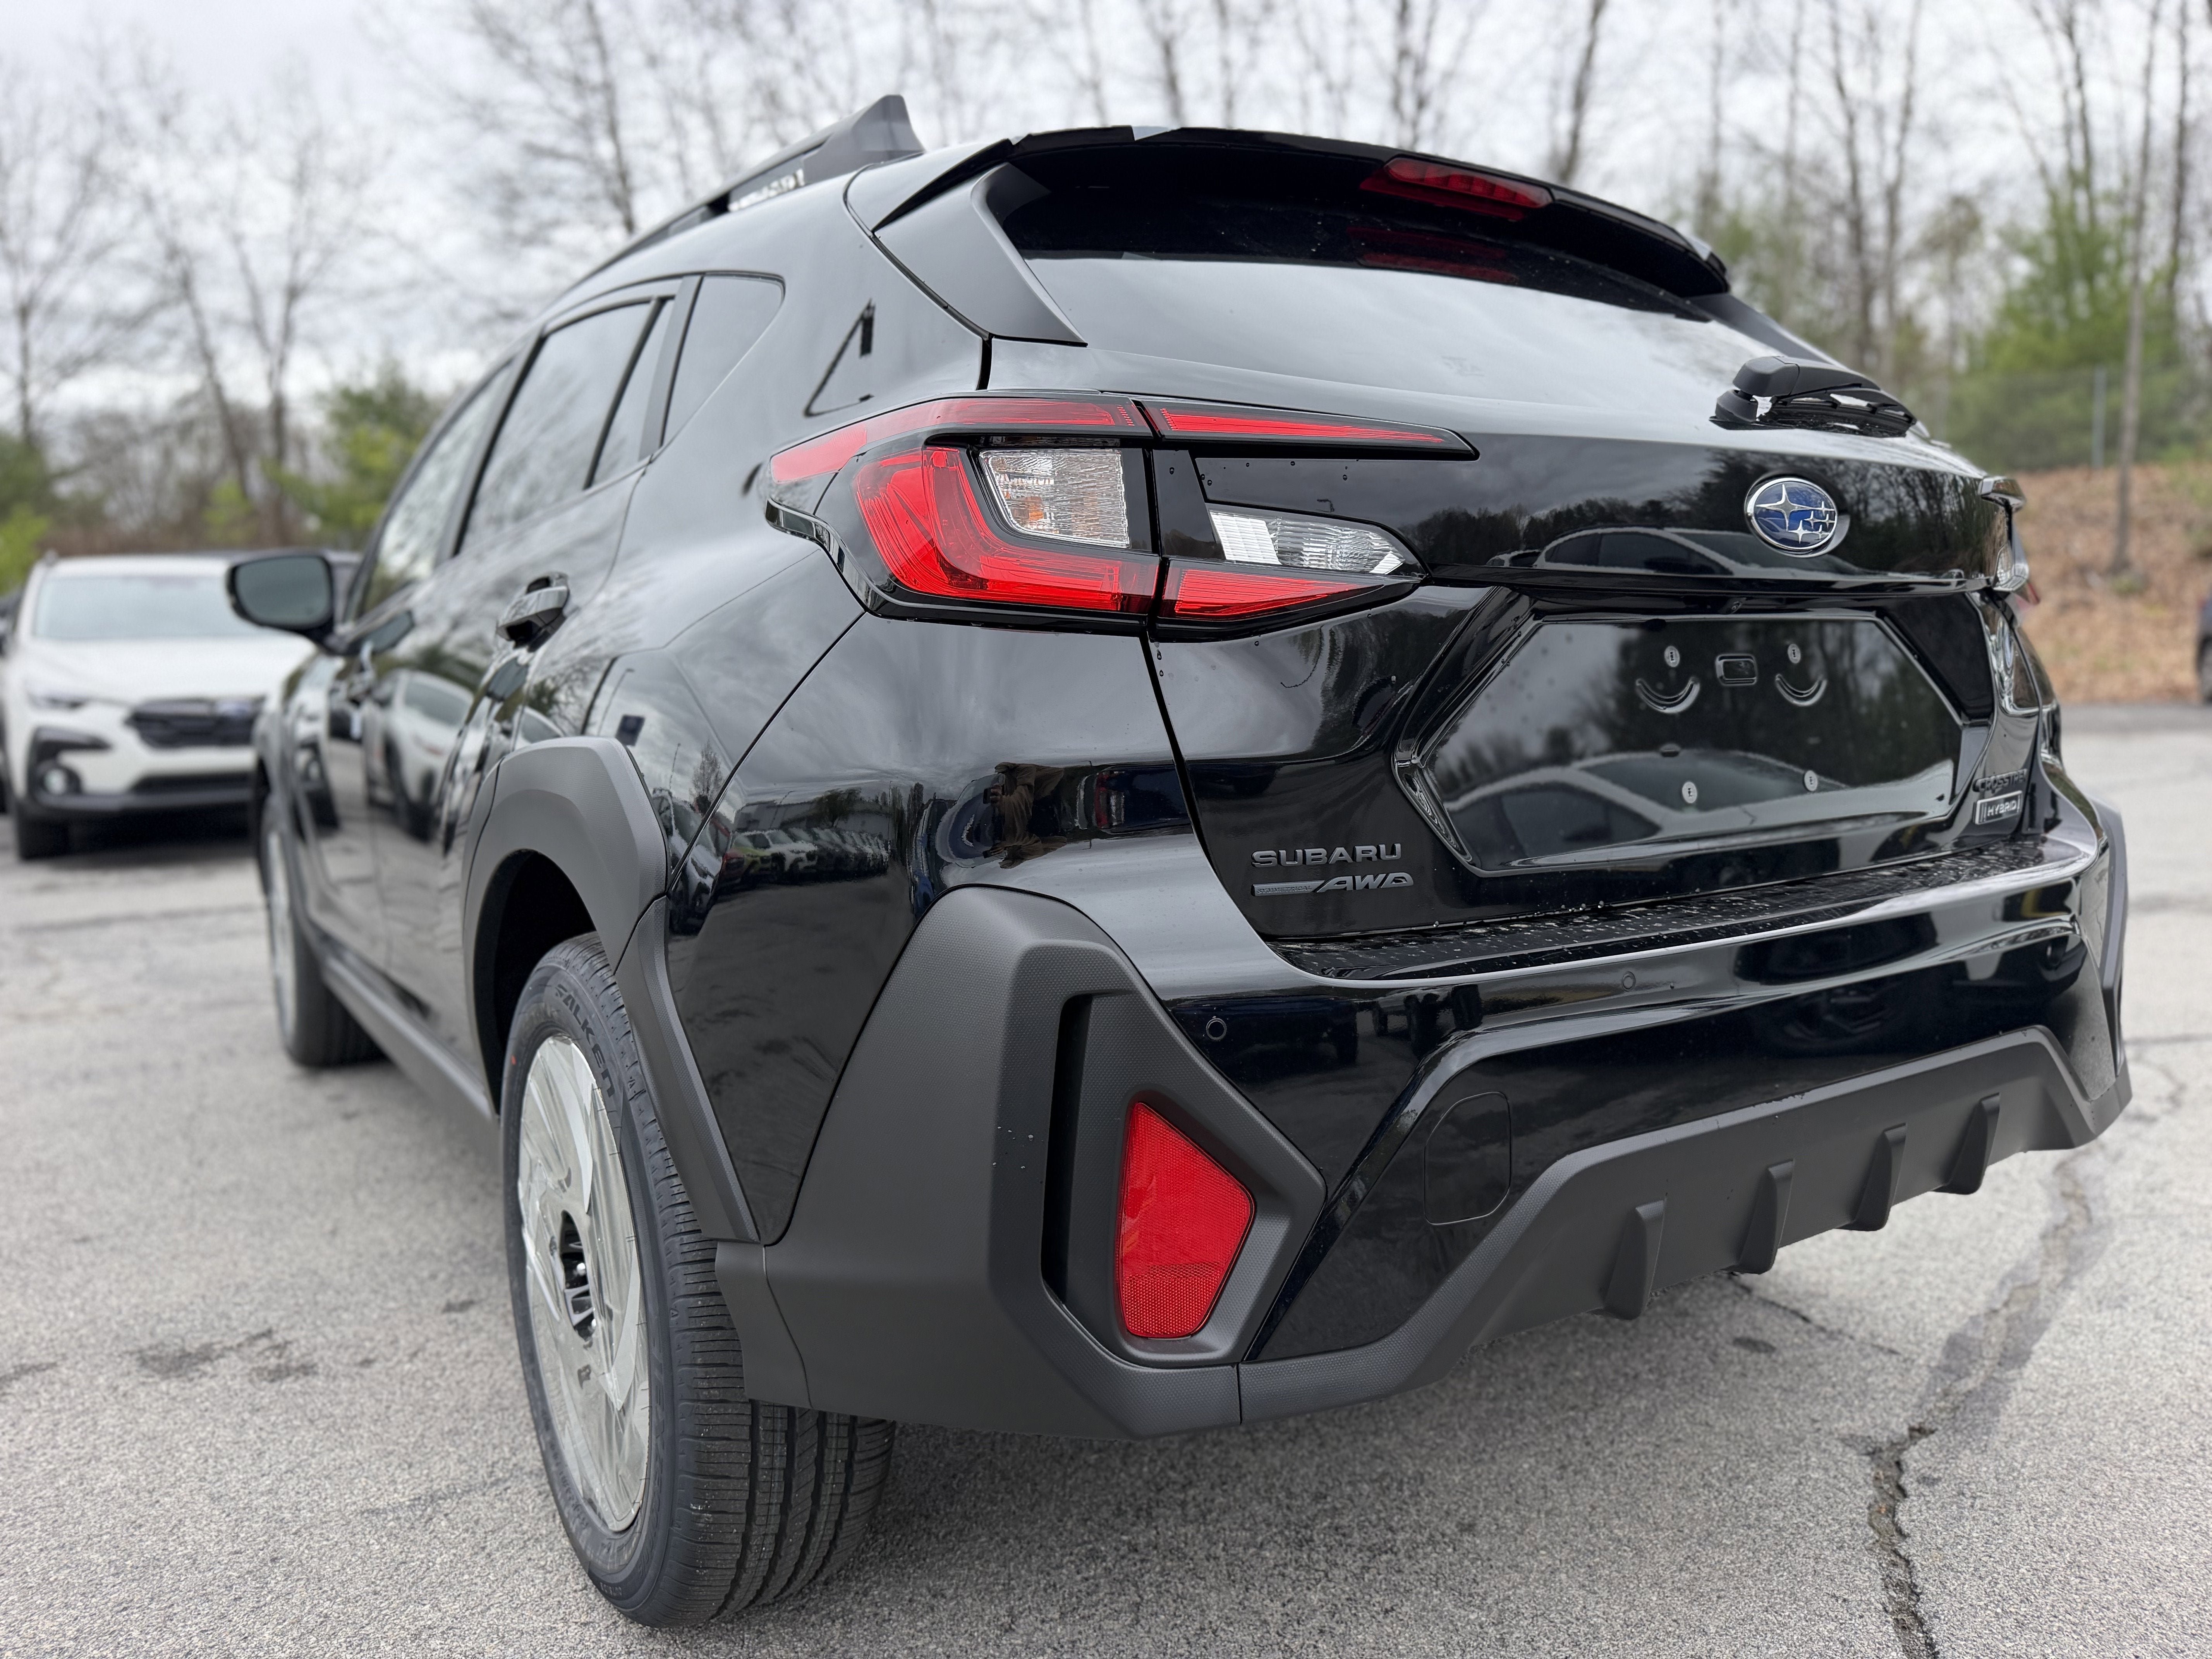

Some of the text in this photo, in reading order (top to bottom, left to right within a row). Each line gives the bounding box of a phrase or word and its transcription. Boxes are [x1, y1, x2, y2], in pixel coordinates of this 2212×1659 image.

[1987, 801, 2016, 816] HYBRID
[1252, 843, 1401, 867] SUBARU
[1257, 872, 1414, 894] SYMMETRICAL AWD
[555, 984, 615, 1097] FALKEN
